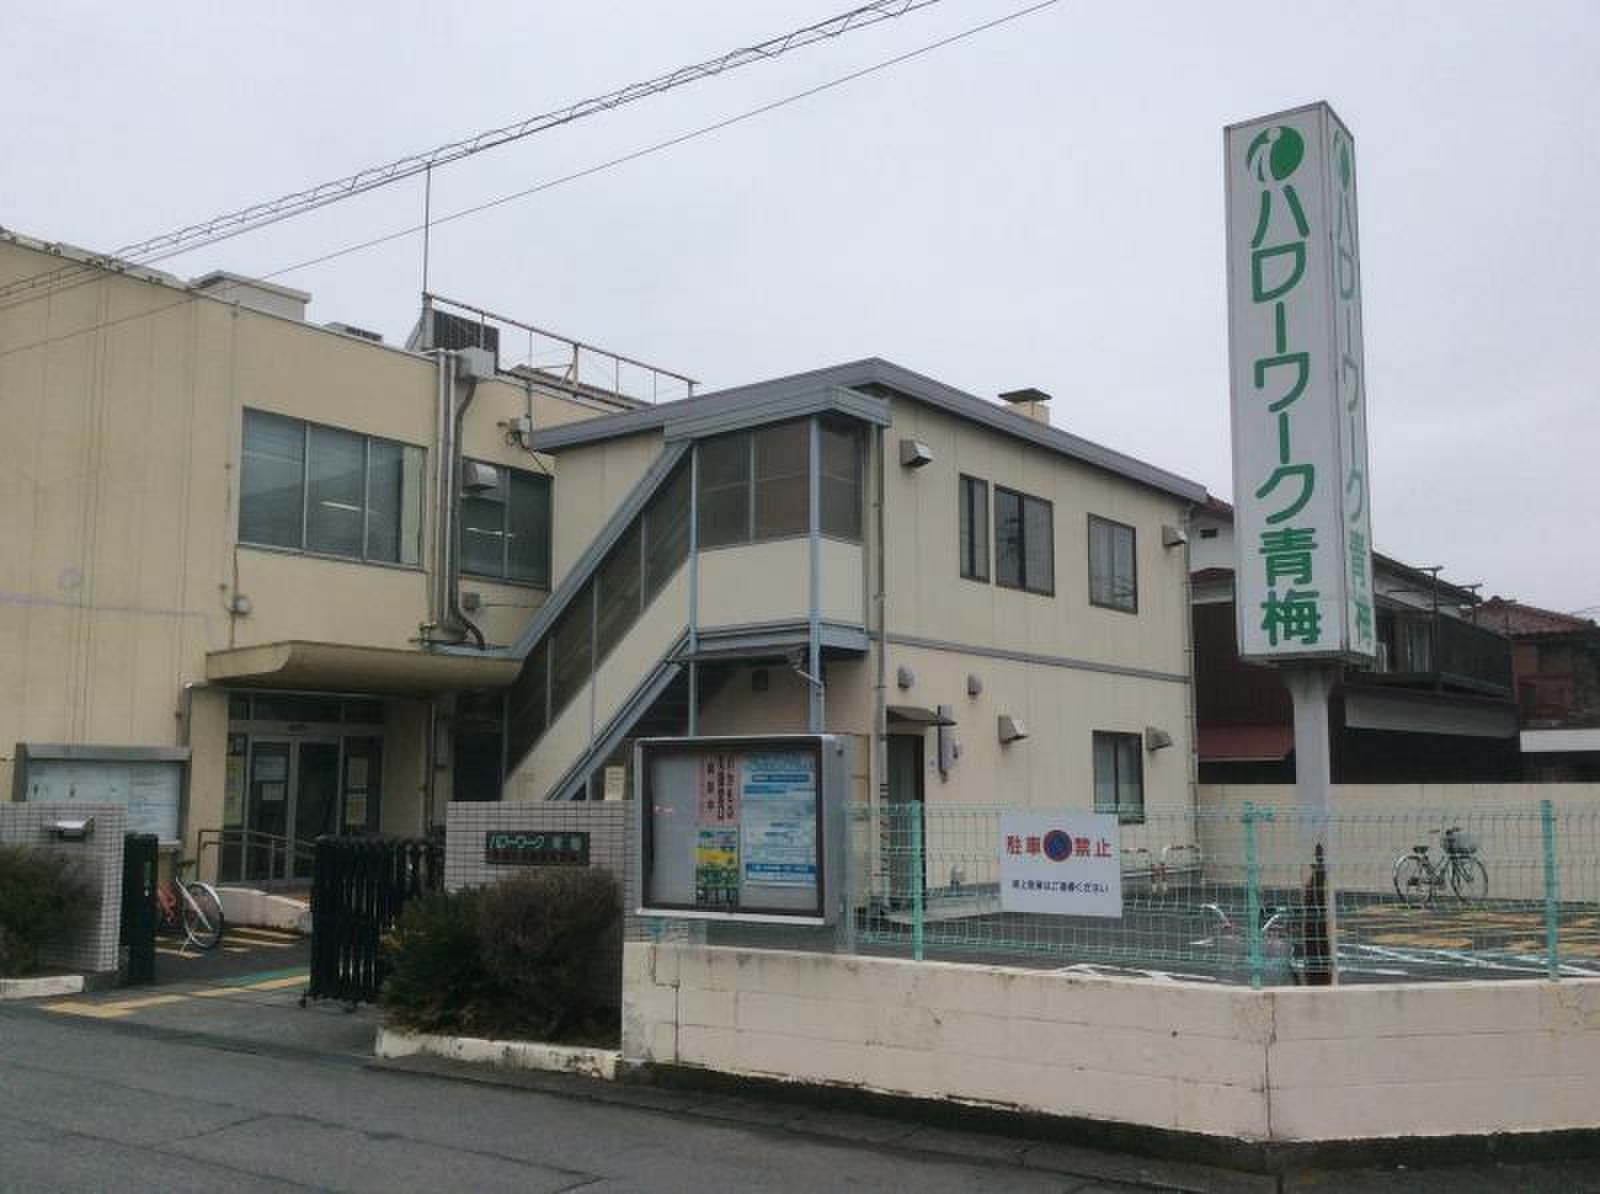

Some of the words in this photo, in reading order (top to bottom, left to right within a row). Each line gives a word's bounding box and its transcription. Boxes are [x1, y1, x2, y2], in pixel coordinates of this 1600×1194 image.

[1251, 184, 1321, 646] ハローワーク青梅
[1007, 836, 1041, 856] 駐車
[1075, 837, 1112, 857] 禁止
